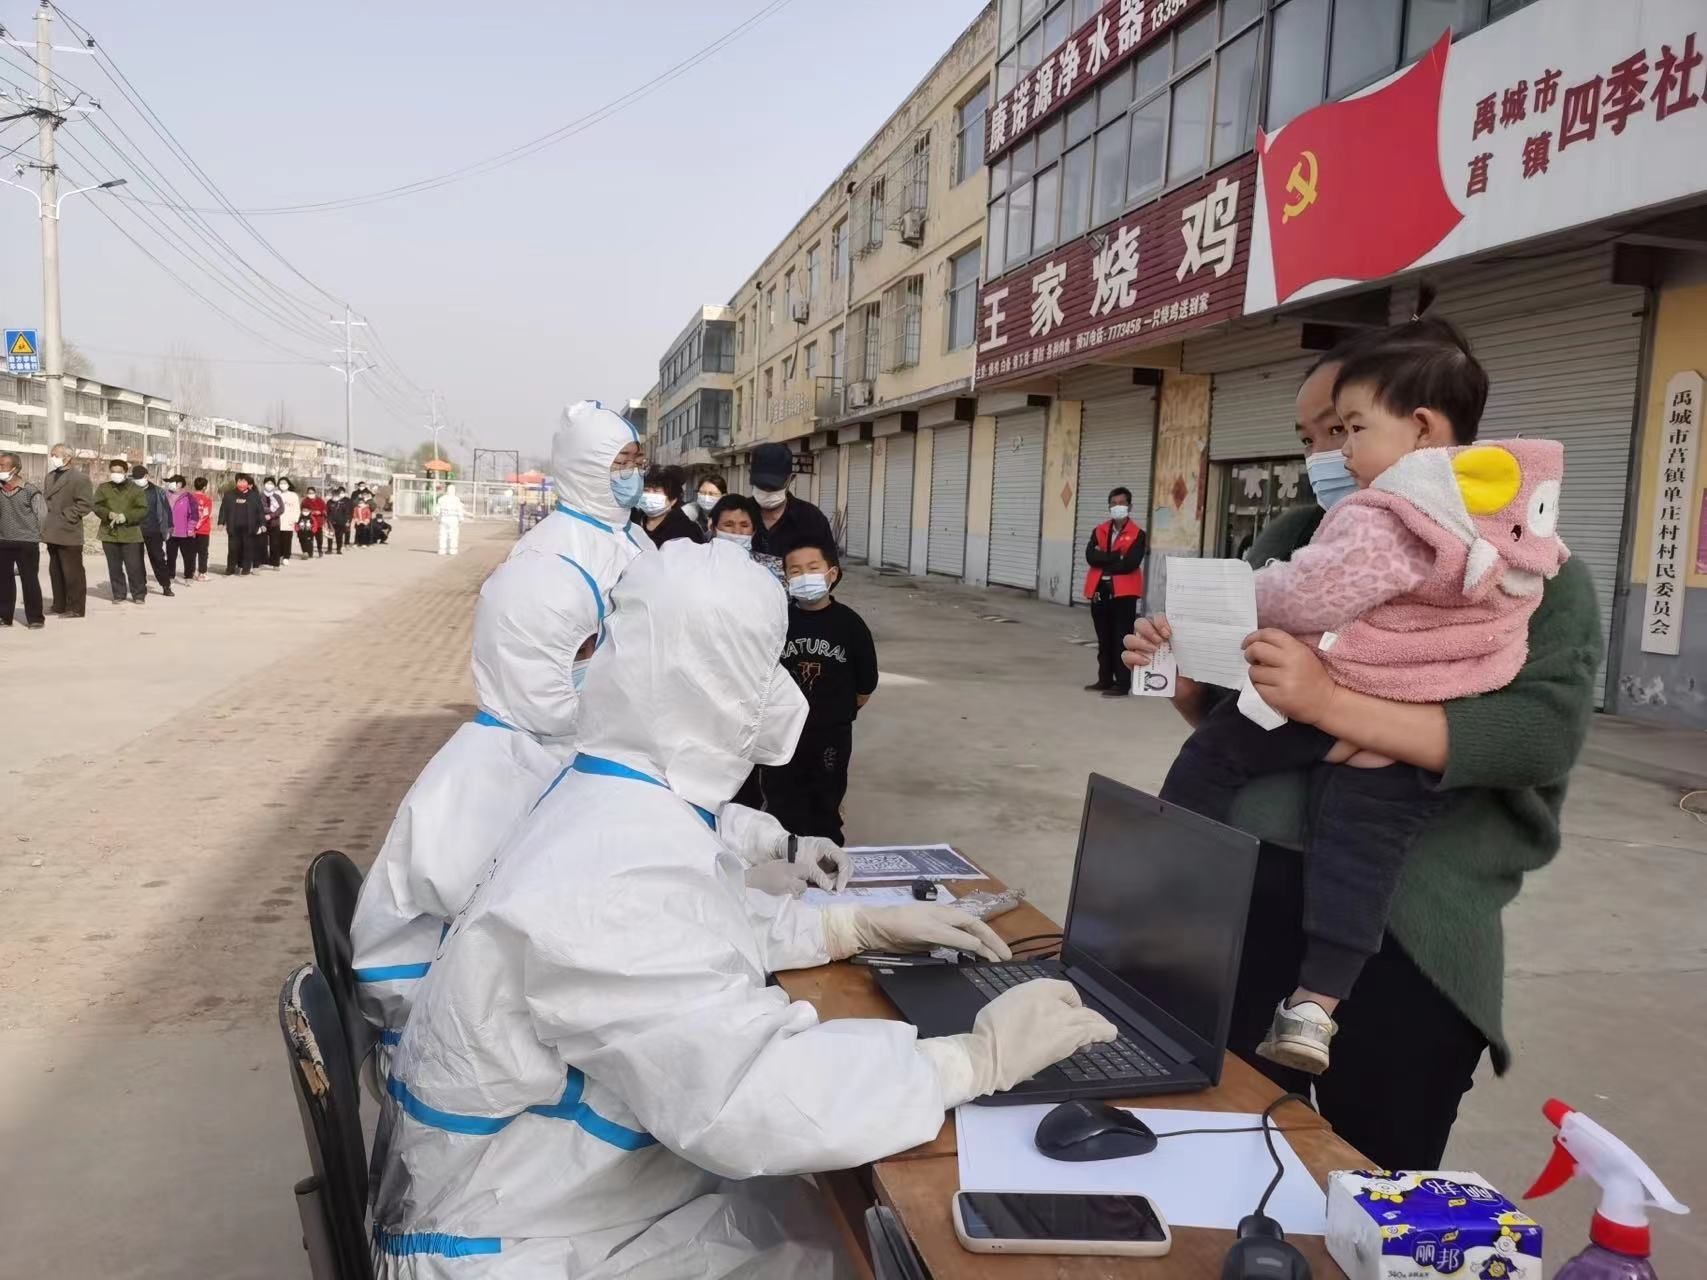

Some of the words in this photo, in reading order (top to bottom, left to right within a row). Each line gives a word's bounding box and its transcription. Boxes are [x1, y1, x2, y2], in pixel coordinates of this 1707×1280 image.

[1472, 69, 1562, 142] 禹城市
[1557, 31, 1707, 152] 四季社
[979, 178, 1240, 352] 王家烧鸡
[1415, 1240, 1460, 1271] 丽邦
